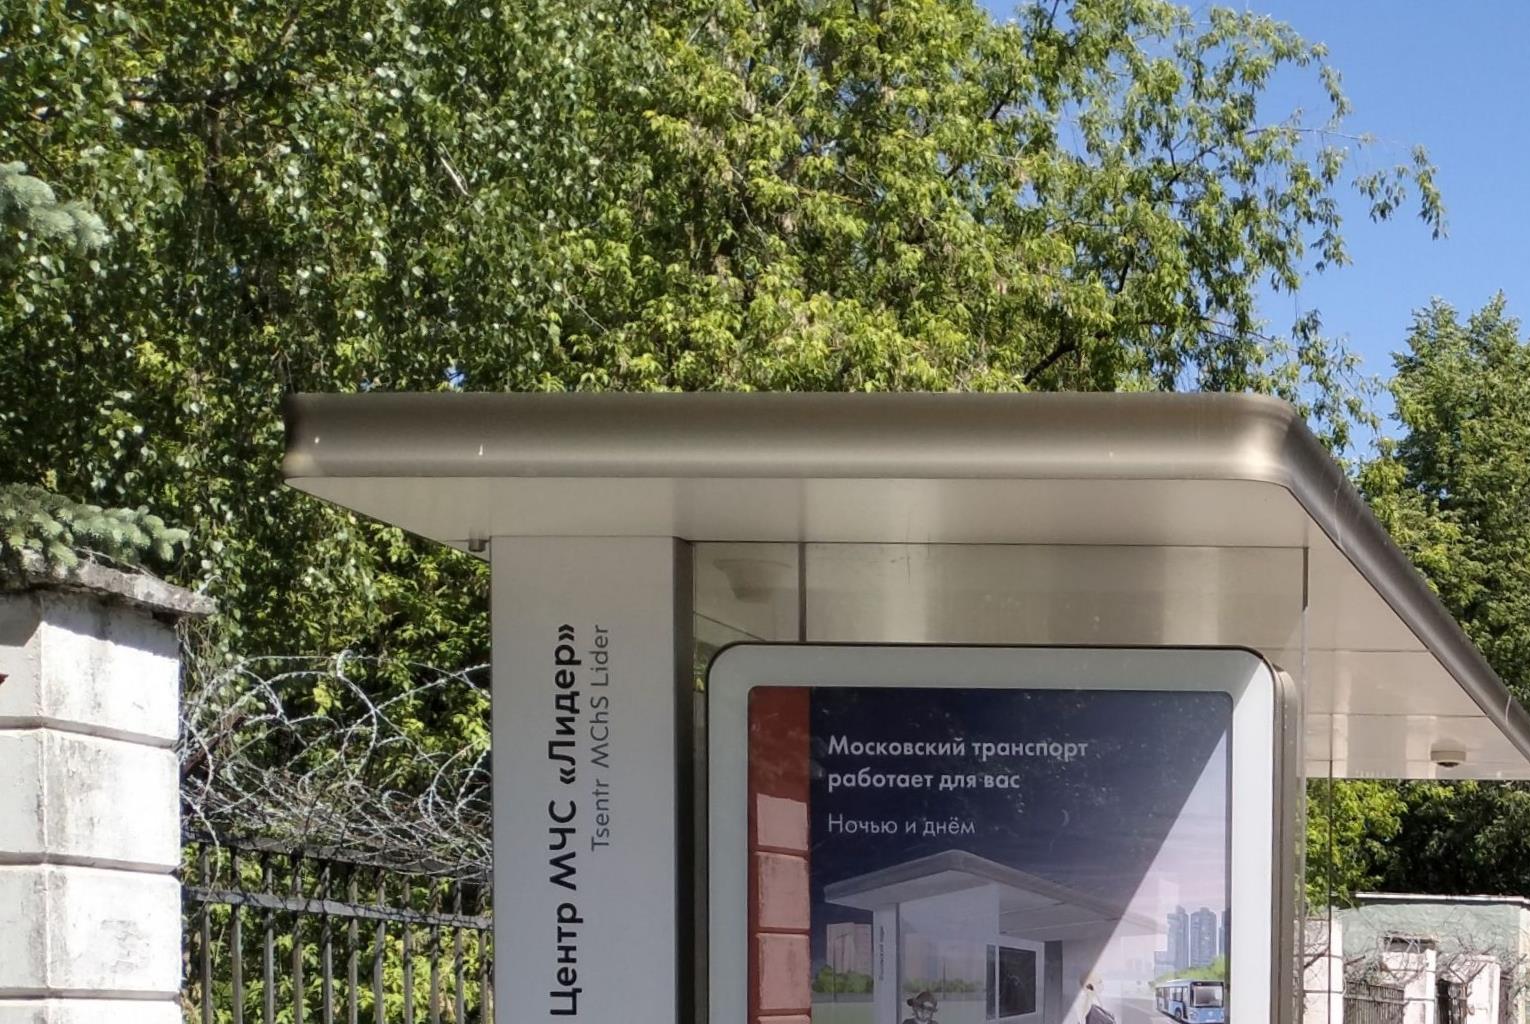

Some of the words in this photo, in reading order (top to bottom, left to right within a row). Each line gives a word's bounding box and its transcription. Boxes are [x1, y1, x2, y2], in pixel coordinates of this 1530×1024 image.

[588, 624, 610, 687] Lider
[548, 623, 582, 785] «Лидер»
[589, 695, 610, 769] MChS
[827, 735, 965, 757] Московский
[972, 742, 1089, 761] транспорт
[827, 767, 933, 793] работает
[939, 772, 977, 792] для
[983, 773, 1021, 790] вас
[548, 799, 577, 891] МЧС
[590, 778, 610, 852] Tsentr
[827, 814, 898, 835] Ночью
[905, 819, 917, 835] и
[922, 817, 976, 837] днём
[550, 902, 583, 1016] Центр
